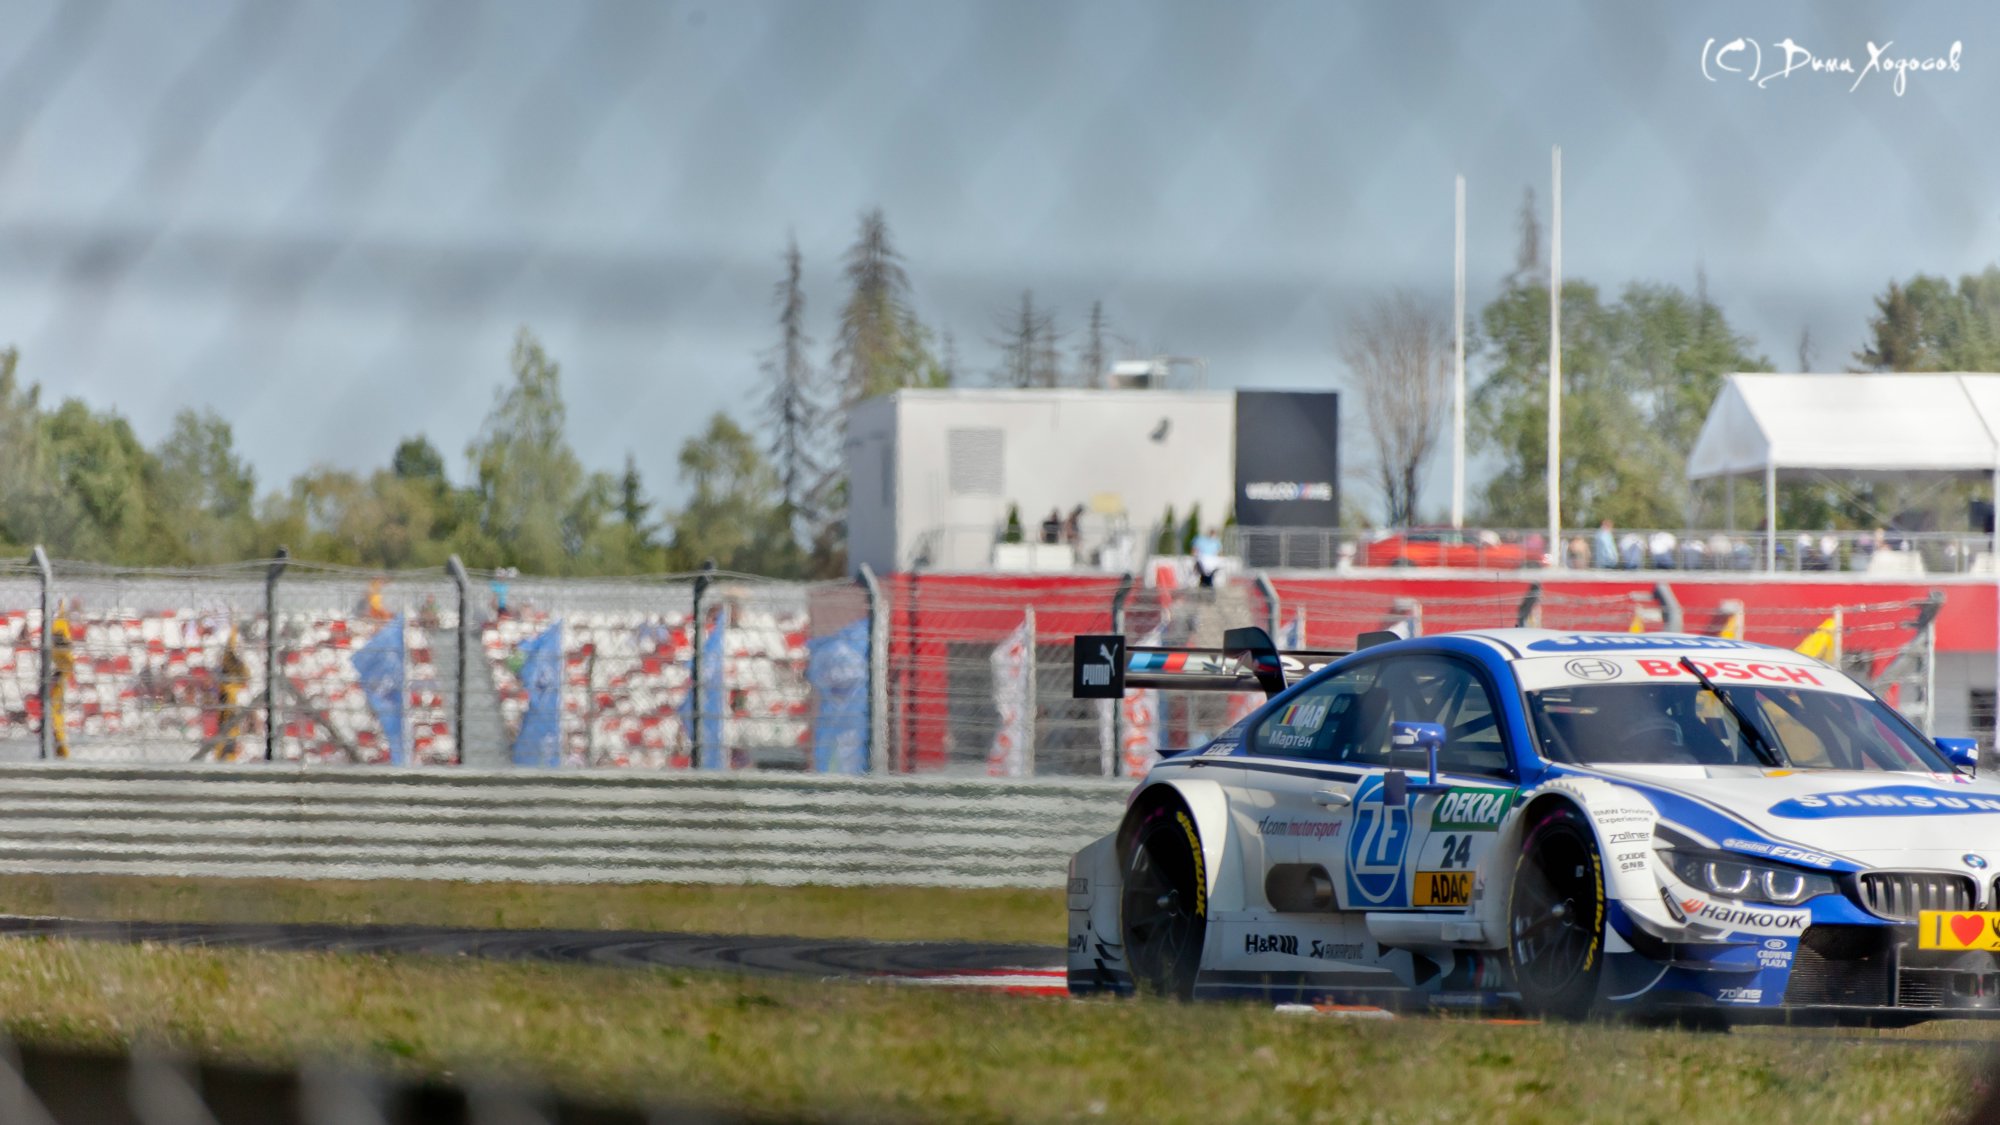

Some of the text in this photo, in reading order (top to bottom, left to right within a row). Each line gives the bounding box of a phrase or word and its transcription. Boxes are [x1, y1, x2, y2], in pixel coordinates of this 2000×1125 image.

[1082, 664, 1111, 686] PUMA
[1637, 659, 1824, 687] BOSCH
[1269, 731, 1312, 749] Мартен
[1440, 792, 1506, 823] DEKRA
[1256, 815, 1342, 841] zf.com/motorsport
[1356, 802, 1406, 874] ZF
[1440, 834, 1473, 868] 24
[1769, 846, 1838, 867] EDGE
[1621, 861, 1645, 870] GNB
[1430, 874, 1469, 904] ADAC
[1245, 934, 1278, 953] H&R
[1757, 950, 1792, 959] CROWNE
[1761, 959, 1787, 968] PLAZA
